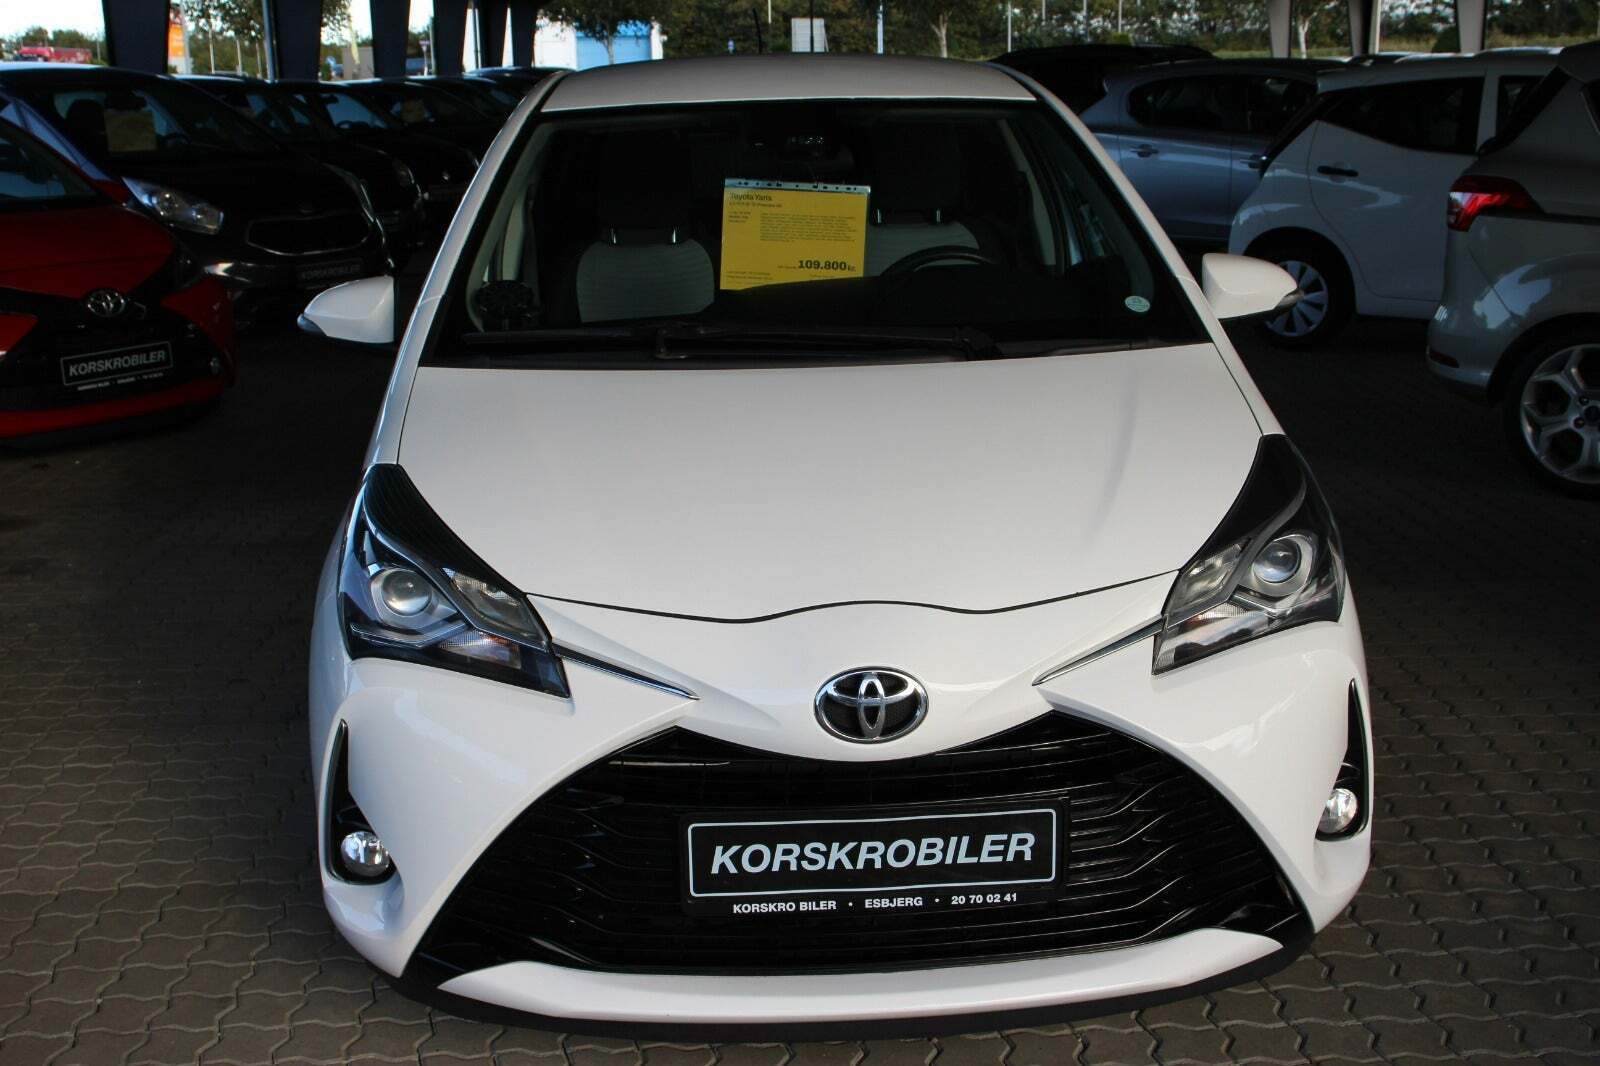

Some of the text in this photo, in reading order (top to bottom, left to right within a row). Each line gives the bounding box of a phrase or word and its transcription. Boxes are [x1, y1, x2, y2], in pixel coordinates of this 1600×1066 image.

[755, 193, 773, 202] Yaris
[798, 259, 847, 271] 109.800
[69, 350, 166, 377] KORSKROBILER
[711, 832, 1036, 875] KORSKROBILER
[733, 892, 1018, 914] KORSKRO BILER ESBJERG 20 70 02 41
